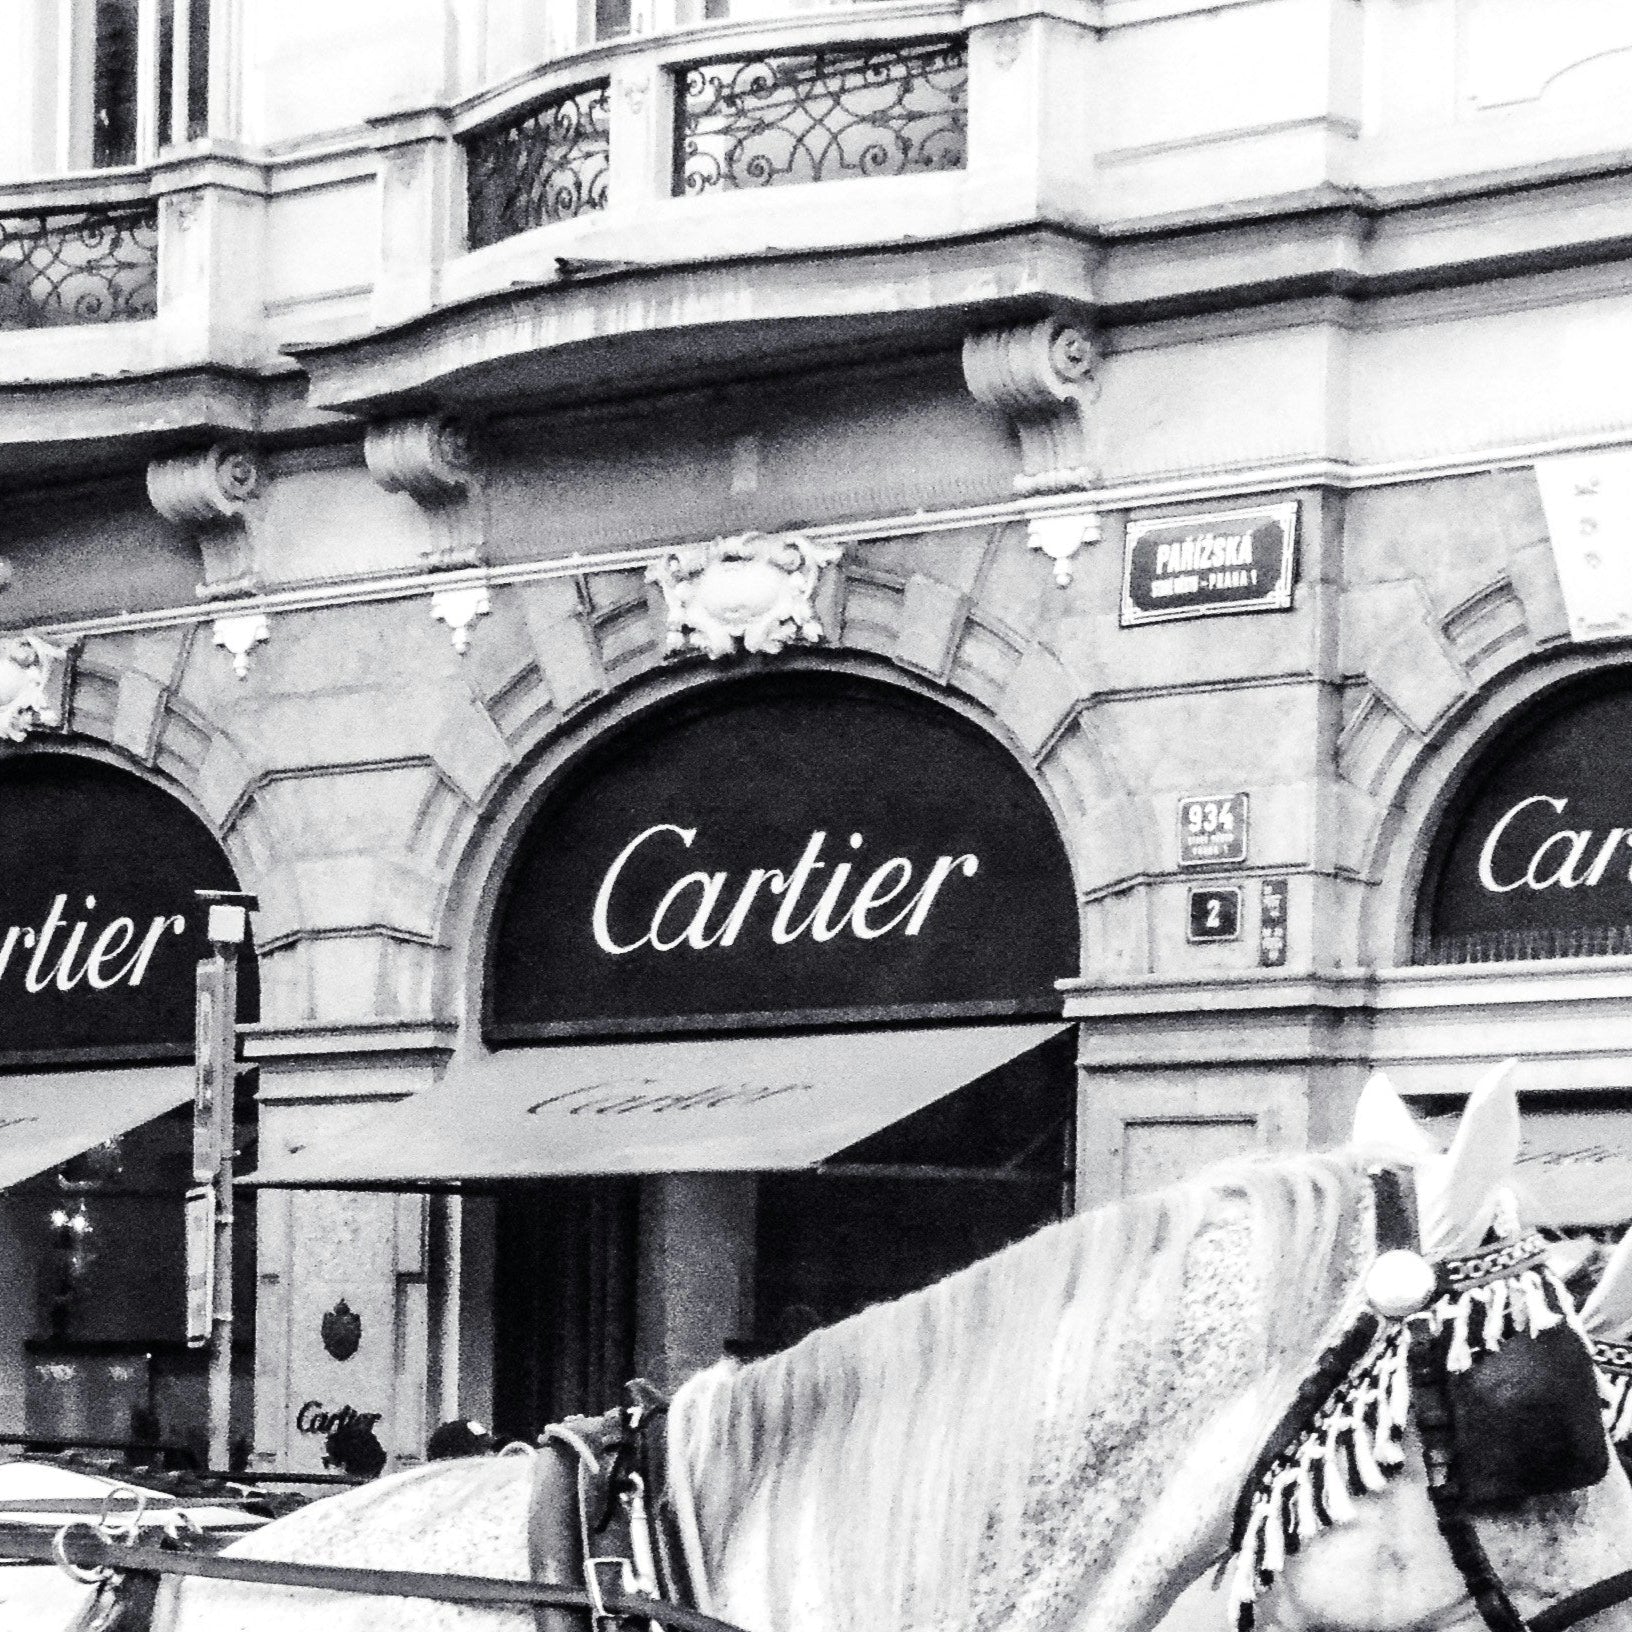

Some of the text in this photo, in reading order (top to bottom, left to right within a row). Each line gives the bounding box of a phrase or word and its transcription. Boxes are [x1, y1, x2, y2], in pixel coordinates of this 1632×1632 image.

[1155, 529, 1254, 575] PAŘÍŽSKÁ
[1188, 802, 1235, 834] 934
[1478, 795, 1632, 893] Car
[593, 824, 978, 954] Cartier
[1206, 899, 1221, 928] 2
